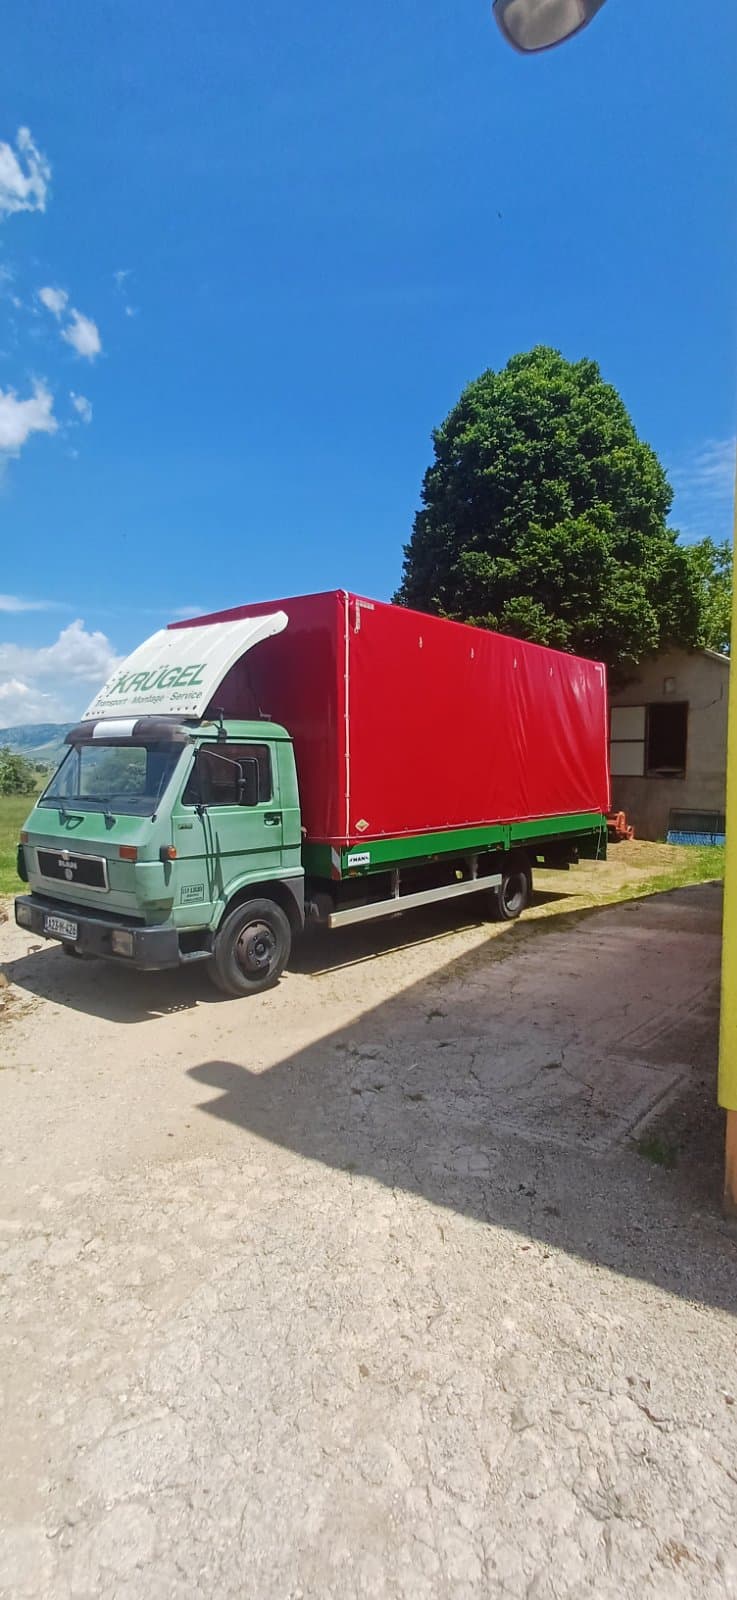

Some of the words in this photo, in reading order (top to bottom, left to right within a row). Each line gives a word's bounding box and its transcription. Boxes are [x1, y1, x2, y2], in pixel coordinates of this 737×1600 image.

[109, 663, 207, 694] KRÜGEL
[131, 695, 165, 705] Montage
[169, 691, 203, 702] Service
